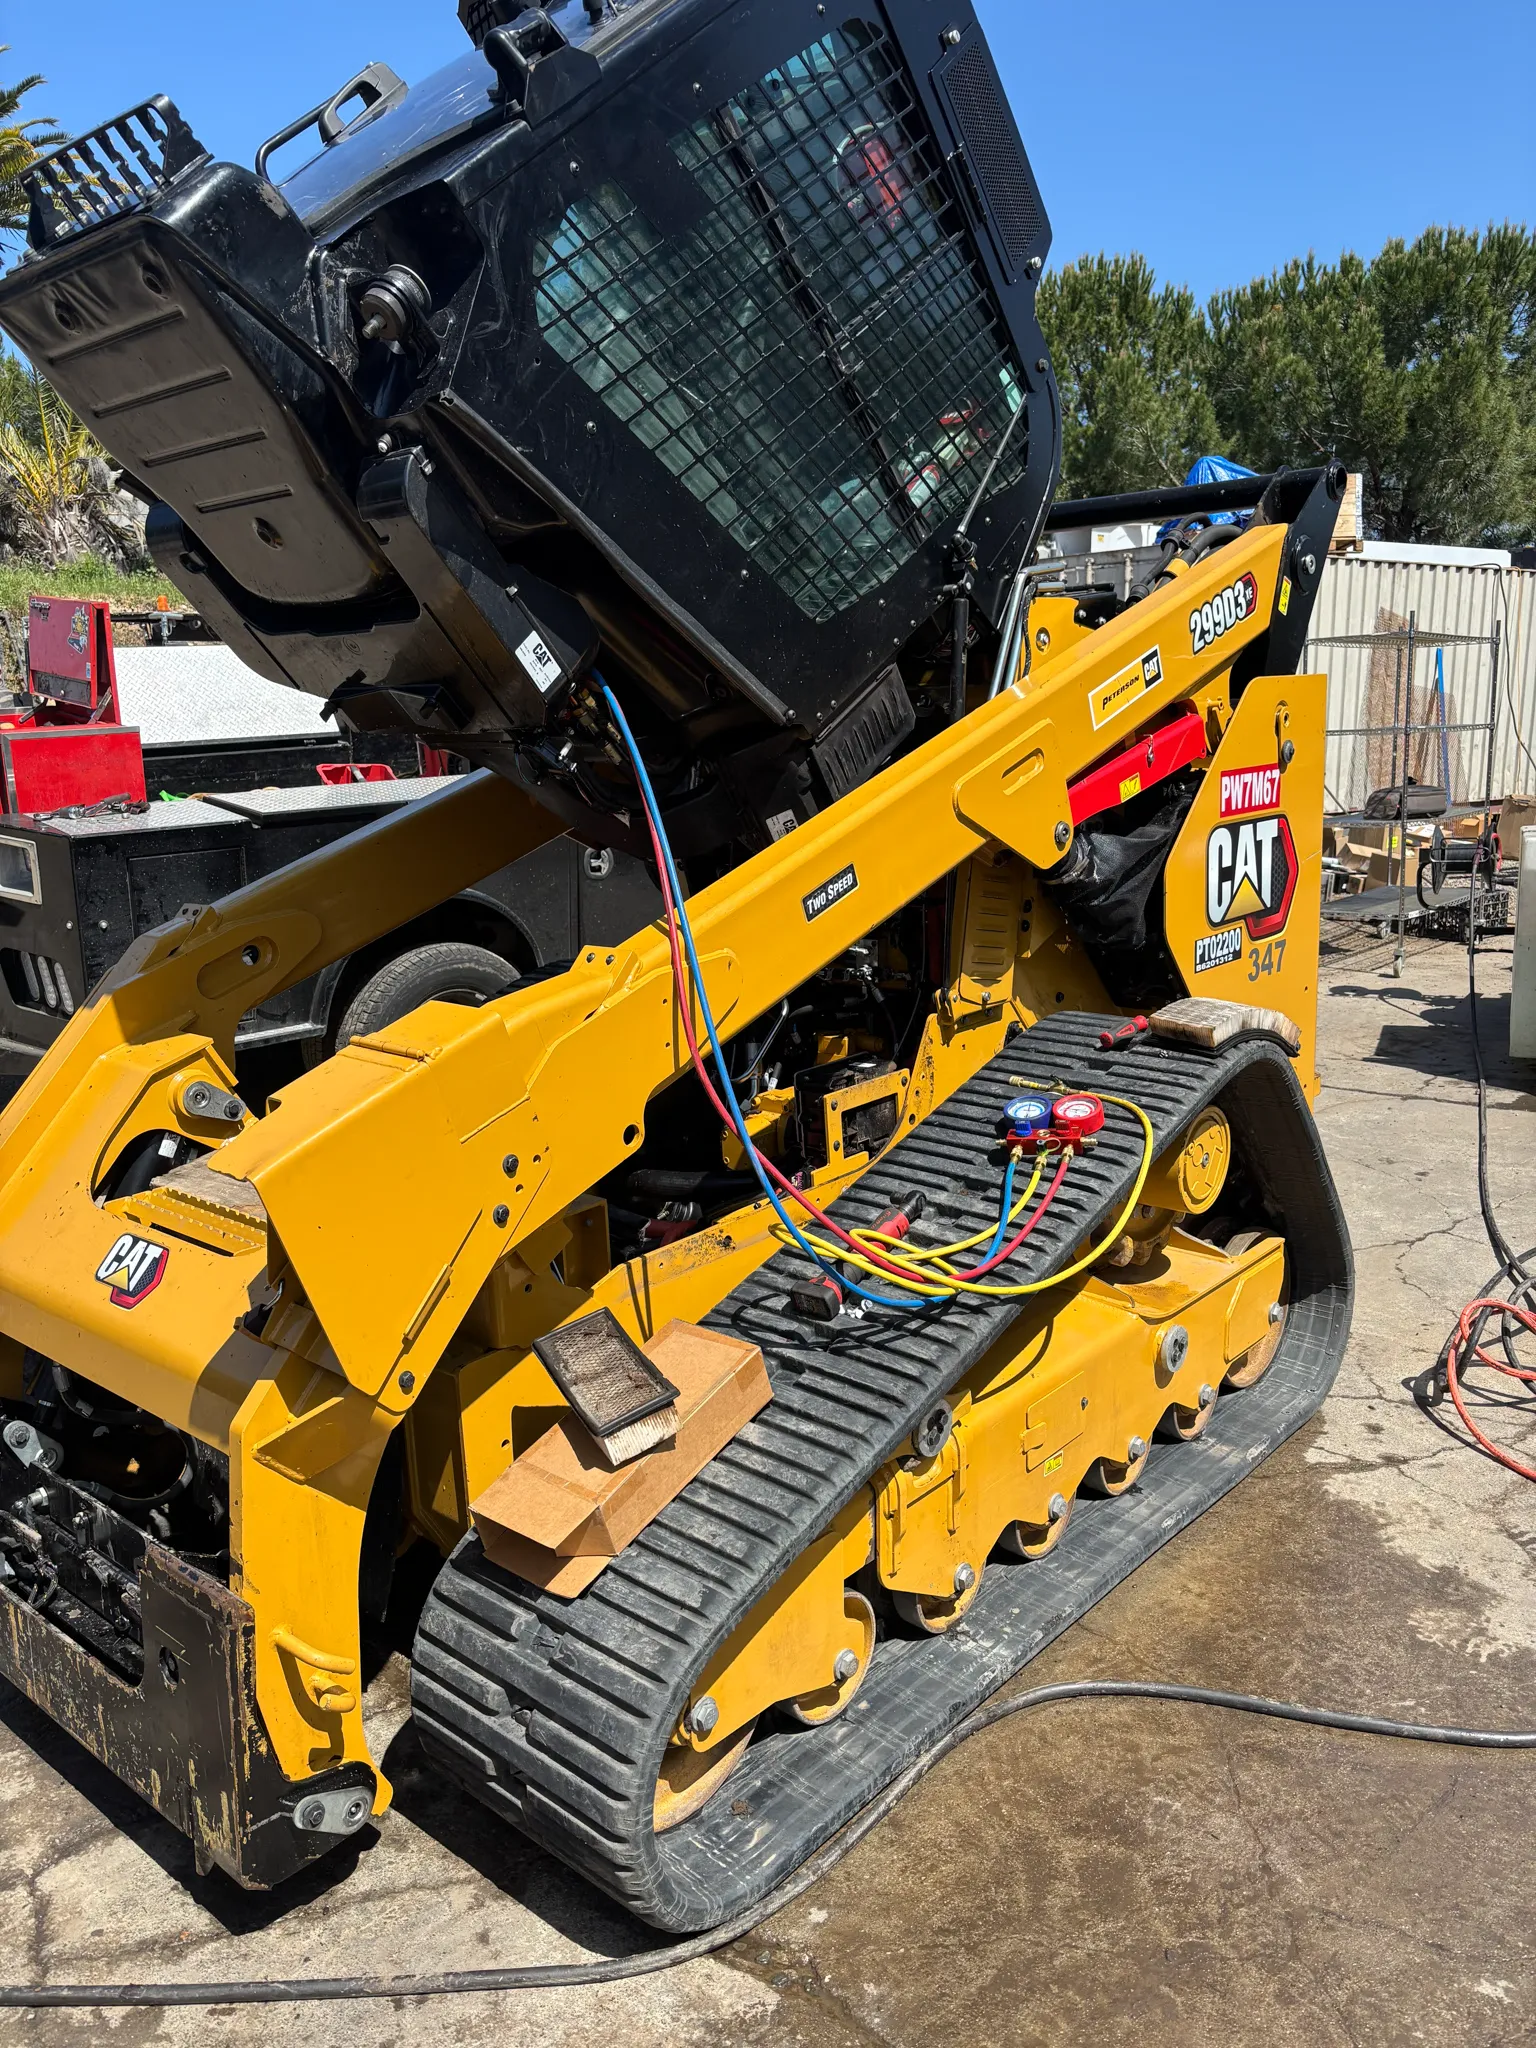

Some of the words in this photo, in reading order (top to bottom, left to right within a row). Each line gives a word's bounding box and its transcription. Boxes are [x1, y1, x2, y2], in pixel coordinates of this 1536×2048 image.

[1190, 580, 1247, 653] 299D3
[533, 643, 552, 668] CAT
[1102, 675, 1140, 711] PETERSON
[1144, 656, 1158, 681] CAT
[1221, 768, 1280, 812] PW7M67
[783, 819, 797, 834] CA
[1208, 818, 1278, 923] CAT
[806, 892, 826, 915] TWO
[828, 873, 853, 900] SPEED
[1195, 953, 1233, 972] B6201312
[1248, 939, 1287, 982] 347
[97, 1234, 164, 1292] CAT
